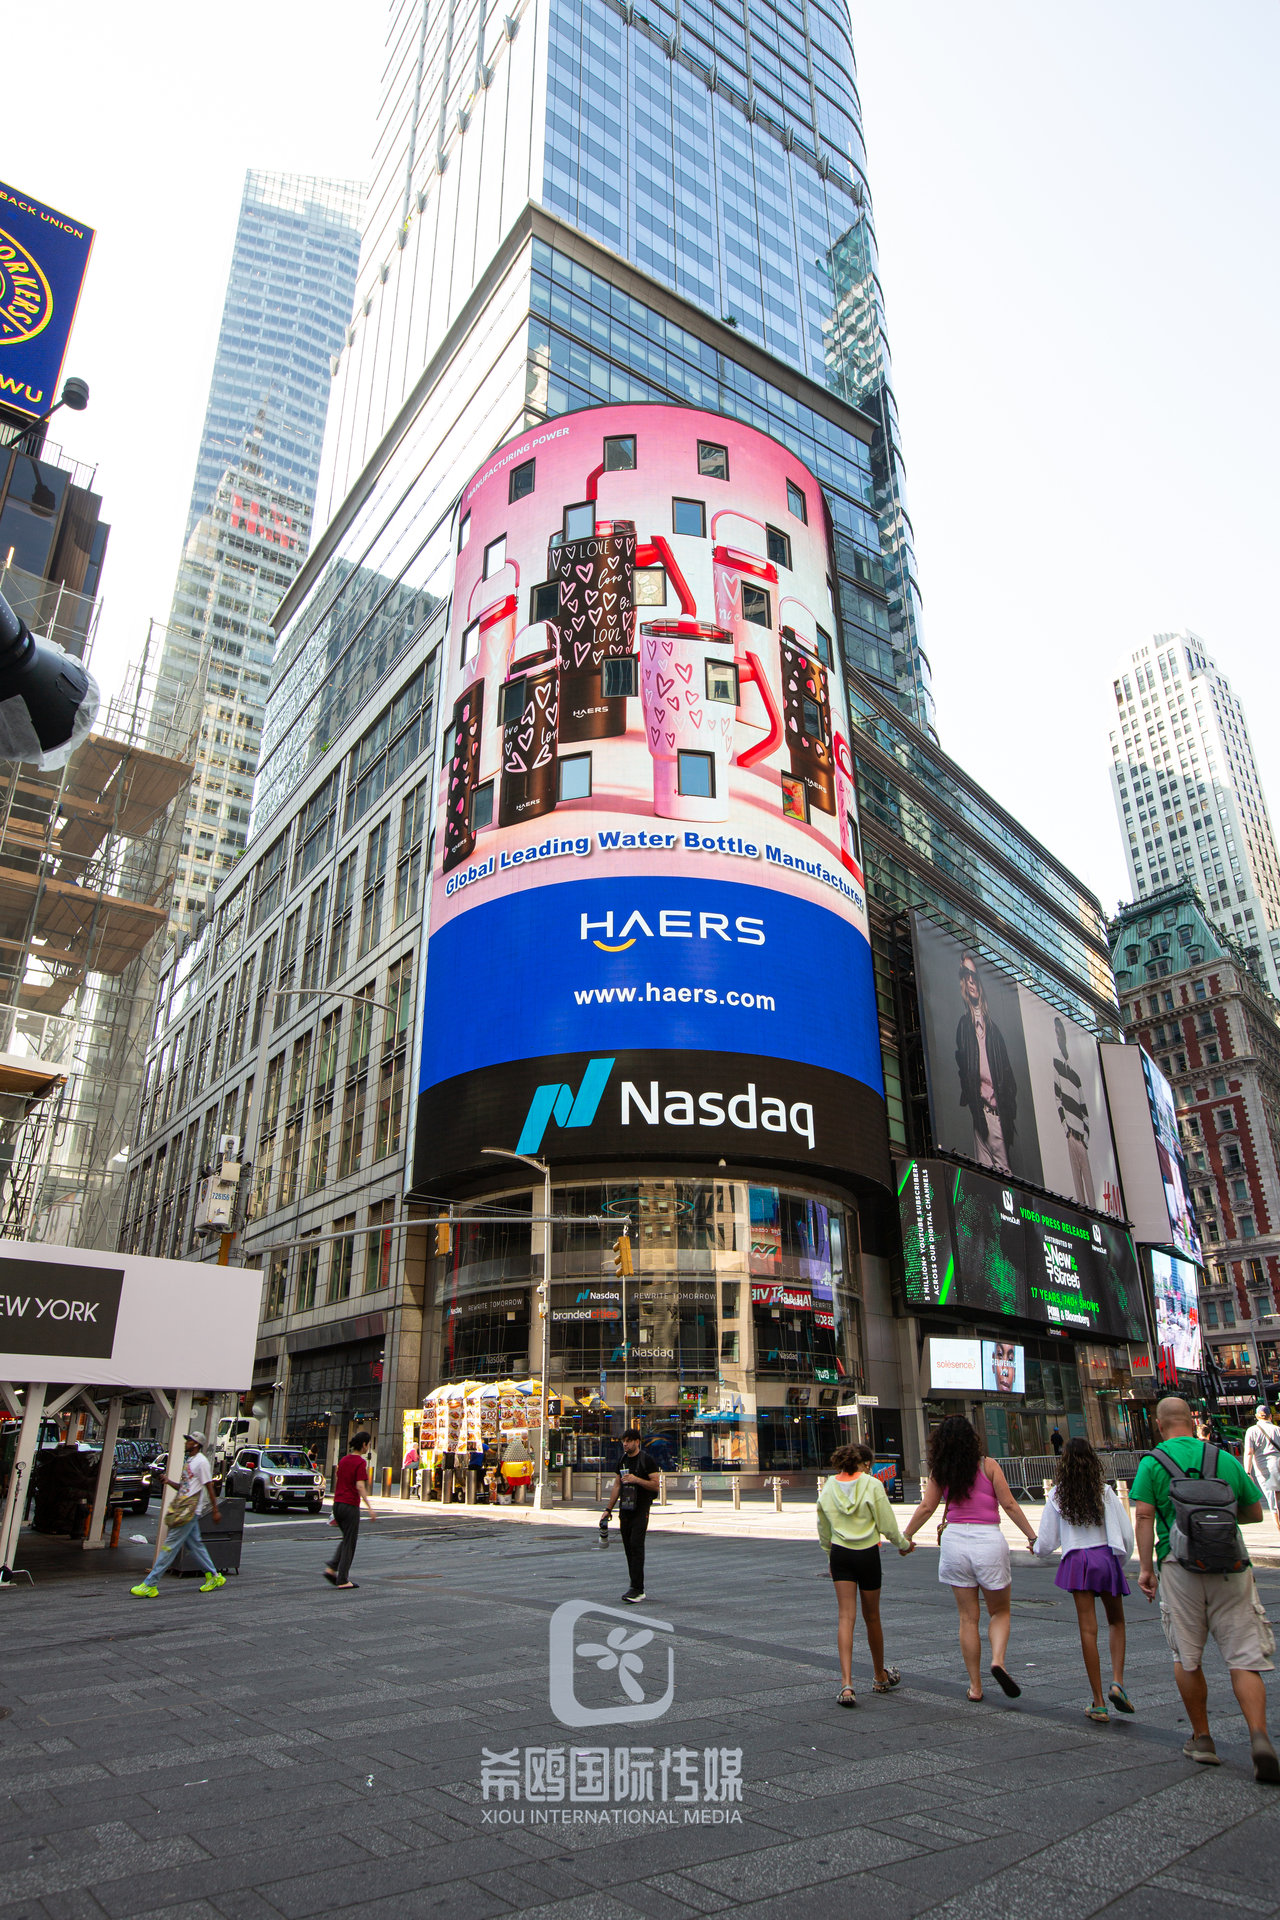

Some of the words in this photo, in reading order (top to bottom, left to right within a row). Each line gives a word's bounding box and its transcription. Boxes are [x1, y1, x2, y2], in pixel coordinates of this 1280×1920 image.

[0, 190, 37, 216] BACK
[40, 211, 84, 240] UNION
[0, 238, 41, 325] ORKERS
[467, 443, 531, 502] MANUFACTURING
[532, 427, 570, 448] POWER
[580, 540, 610, 558] LOVE
[573, 706, 609, 718] HAERS
[804, 776, 828, 794] HAERS
[516, 799, 541, 811] HAERS
[445, 857, 495, 896] Global
[500, 837, 589, 868] Leading
[598, 830, 675, 848] Water
[684, 831, 758, 856] Bottle
[765, 844, 863, 909] Manufacturer
[580, 909, 767, 947] HAERS
[574, 982, 776, 1012] www.haers.com
[620, 1080, 816, 1150] Nasdaq
[912, 1163, 922, 1215] SUBSCRIBERS
[922, 1169, 931, 1210] CHANNELS
[917, 1217, 926, 1254] YOUTUBE
[926, 1211, 934, 1243] DIGITAL
[1019, 1206, 1041, 1224] VIDEO
[1041, 1214, 1061, 1231] PRESS
[1061, 1221, 1090, 1241] RELEASES
[929, 1244, 937, 1261] OUR
[1050, 1244, 1071, 1270] New
[921, 1256, 930, 1294] MILLION+
[932, 1263, 940, 1296] ACROSS
[1053, 1265, 1080, 1290] Street
[34, 1297, 100, 1323] YORK
[590, 1291, 620, 1301] Nasdaq
[633, 1292, 668, 1300] REWRITE
[672, 1291, 717, 1301] TOMORROW
[1030, 1286, 1038, 1299] 17
[1079, 1299, 1100, 1313] SHOWS
[552, 1307, 619, 1320] brandedcities
[631, 1346, 674, 1360] Nasdaq
